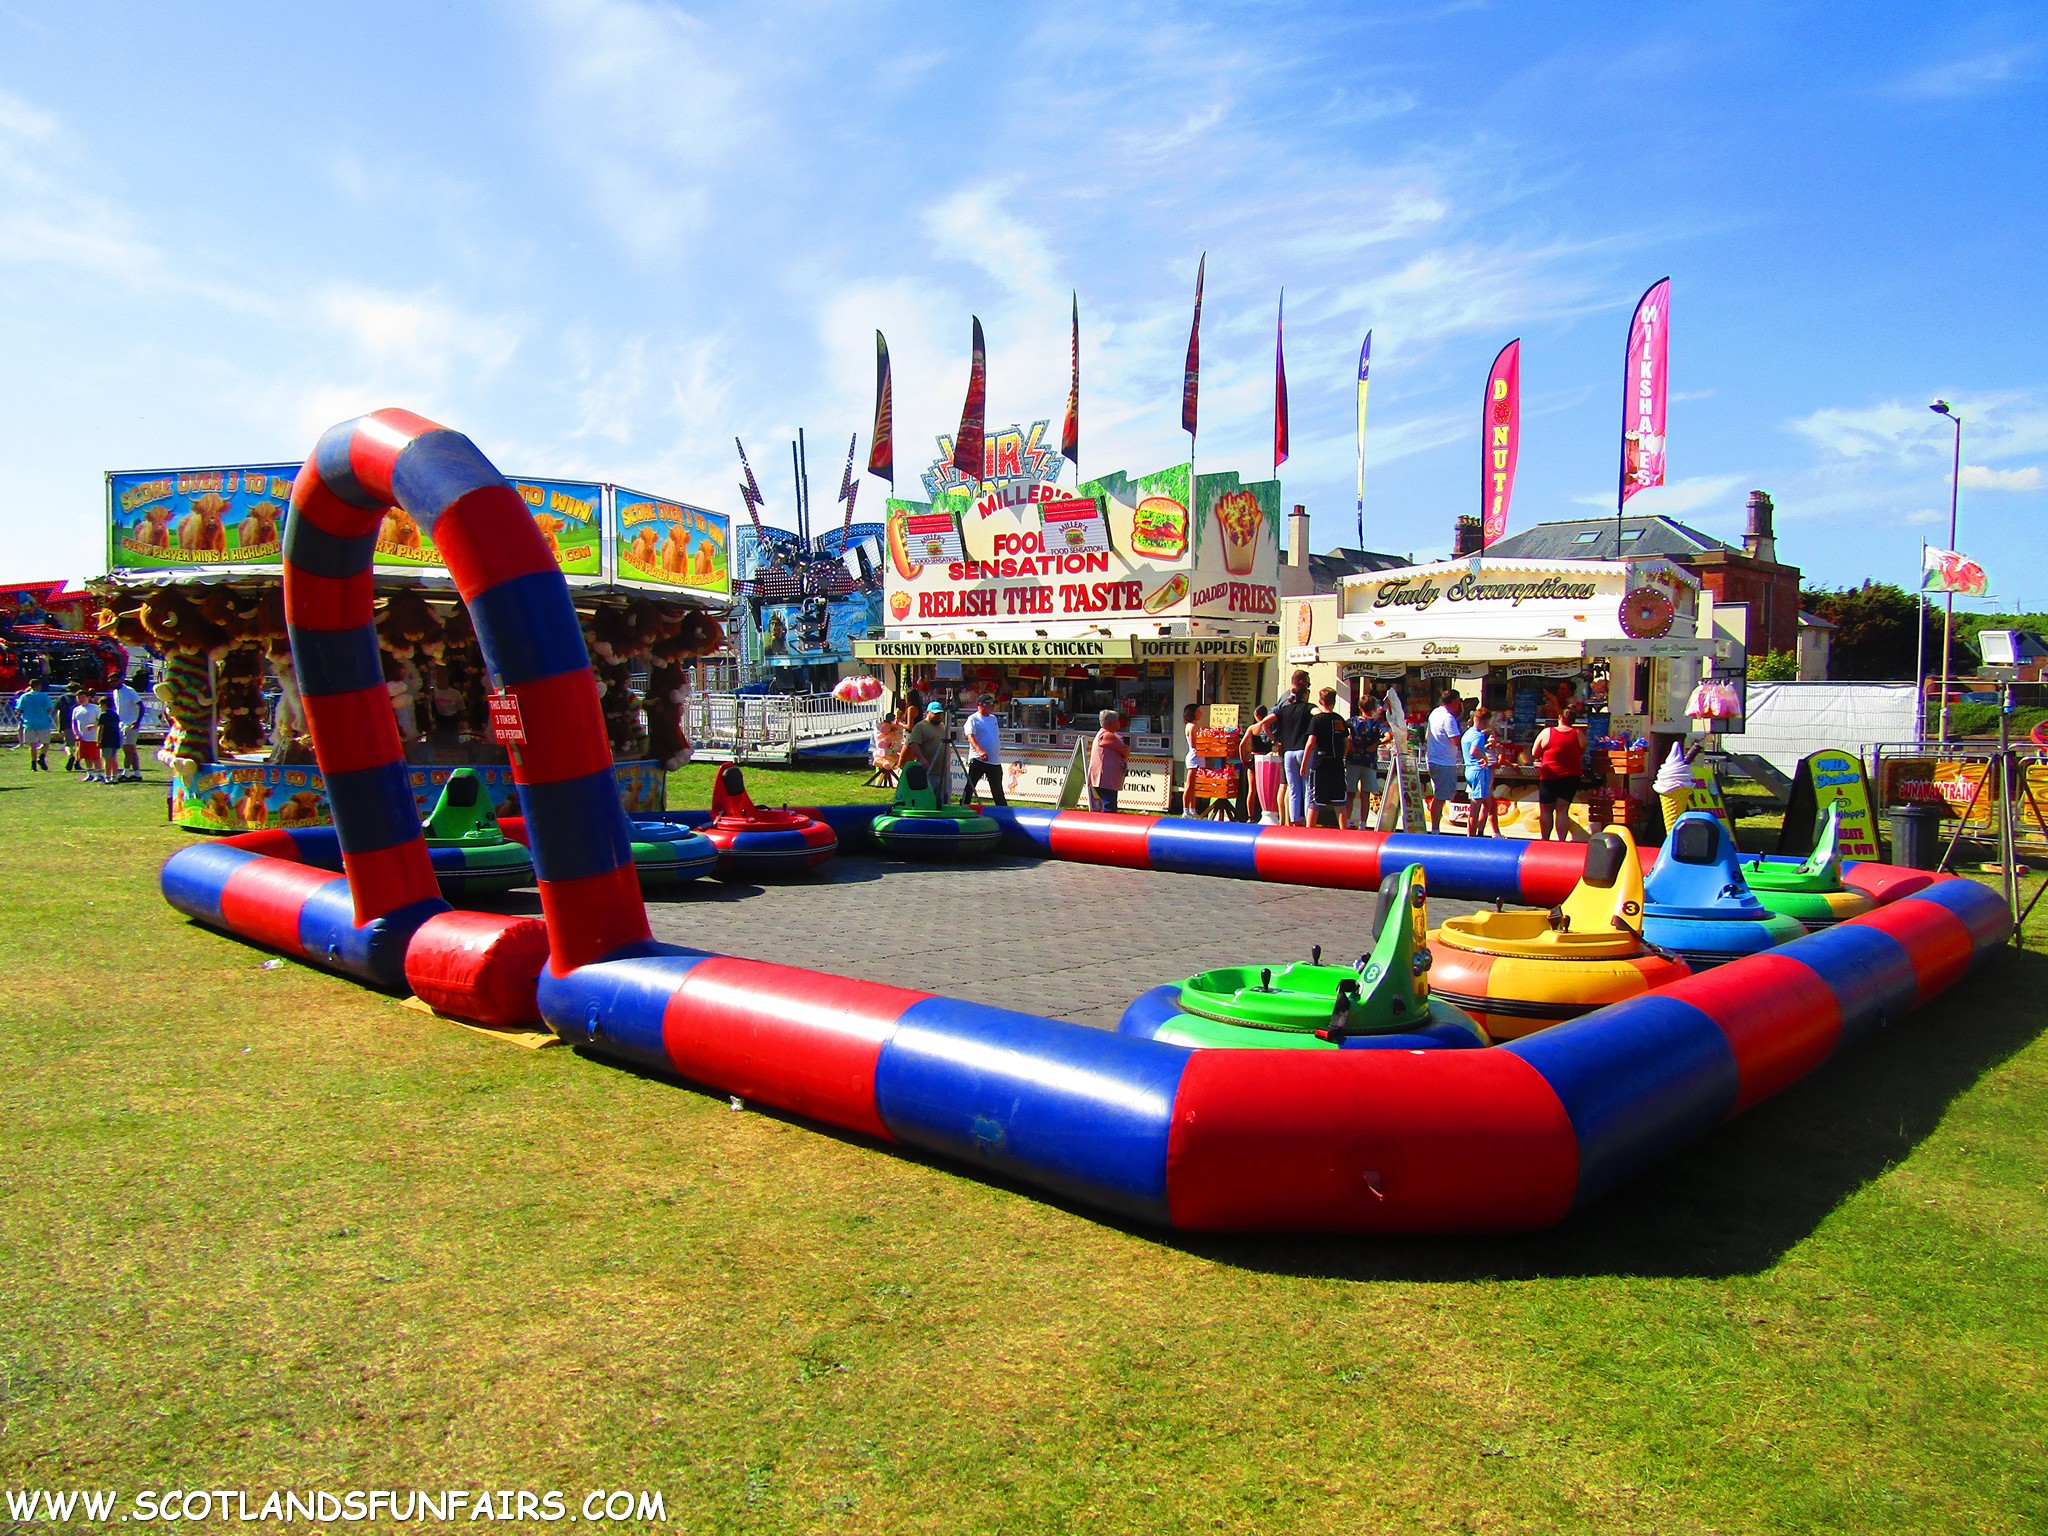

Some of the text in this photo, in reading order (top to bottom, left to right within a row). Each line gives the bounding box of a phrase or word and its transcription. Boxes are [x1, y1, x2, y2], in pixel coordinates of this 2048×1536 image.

[1638, 305, 1656, 486] MILKSHAKES
[120, 471, 294, 513] SCORE OVER 3 TO WI
[516, 483, 593, 524] TO WIN
[621, 502, 657, 528] SCORE
[657, 501, 685, 525] OVER
[693, 513, 706, 534] TO
[1058, 521, 1088, 534] MILLER'S
[153, 544, 191, 562] PLAYER
[192, 549, 220, 563] WINS
[221, 549, 231, 561] A
[232, 540, 282, 561] HIGHLAND
[565, 545, 592, 562] COW
[1051, 545, 1103, 555] FOOD SENSATION
[948, 552, 1109, 581] SENSATION
[918, 580, 1143, 618] RELISH THE TASTE
[1192, 581, 1277, 614] LOADED FRIES
[1373, 574, 1596, 611] Truly Scrumptious
[875, 642, 1104, 656] FRESHLY PREPARED STEAK & CHICKEN
[1140, 640, 1247, 655] TOFFEE APPLES
[1255, 639, 1277, 654] SWEETS
[1511, 668, 1542, 676] DONUTS
[490, 700, 500, 710] THIS
[511, 700, 517, 710] IS
[495, 714, 518, 725] 3 TOKENS
[505, 729, 524, 739] PERSON
[769, 731, 787, 740] EXIT
[270, 768, 281, 784] 3
[285, 769, 307, 787] TO
[1036, 776, 1058, 787] CHIPS
[1123, 782, 1156, 793] CHICKEN
[1943, 780, 1975, 802] TRAIN
[1839, 828, 1864, 840] REATE
[1625, 903, 1636, 913] 3
[1366, 966, 1379, 979] 8
